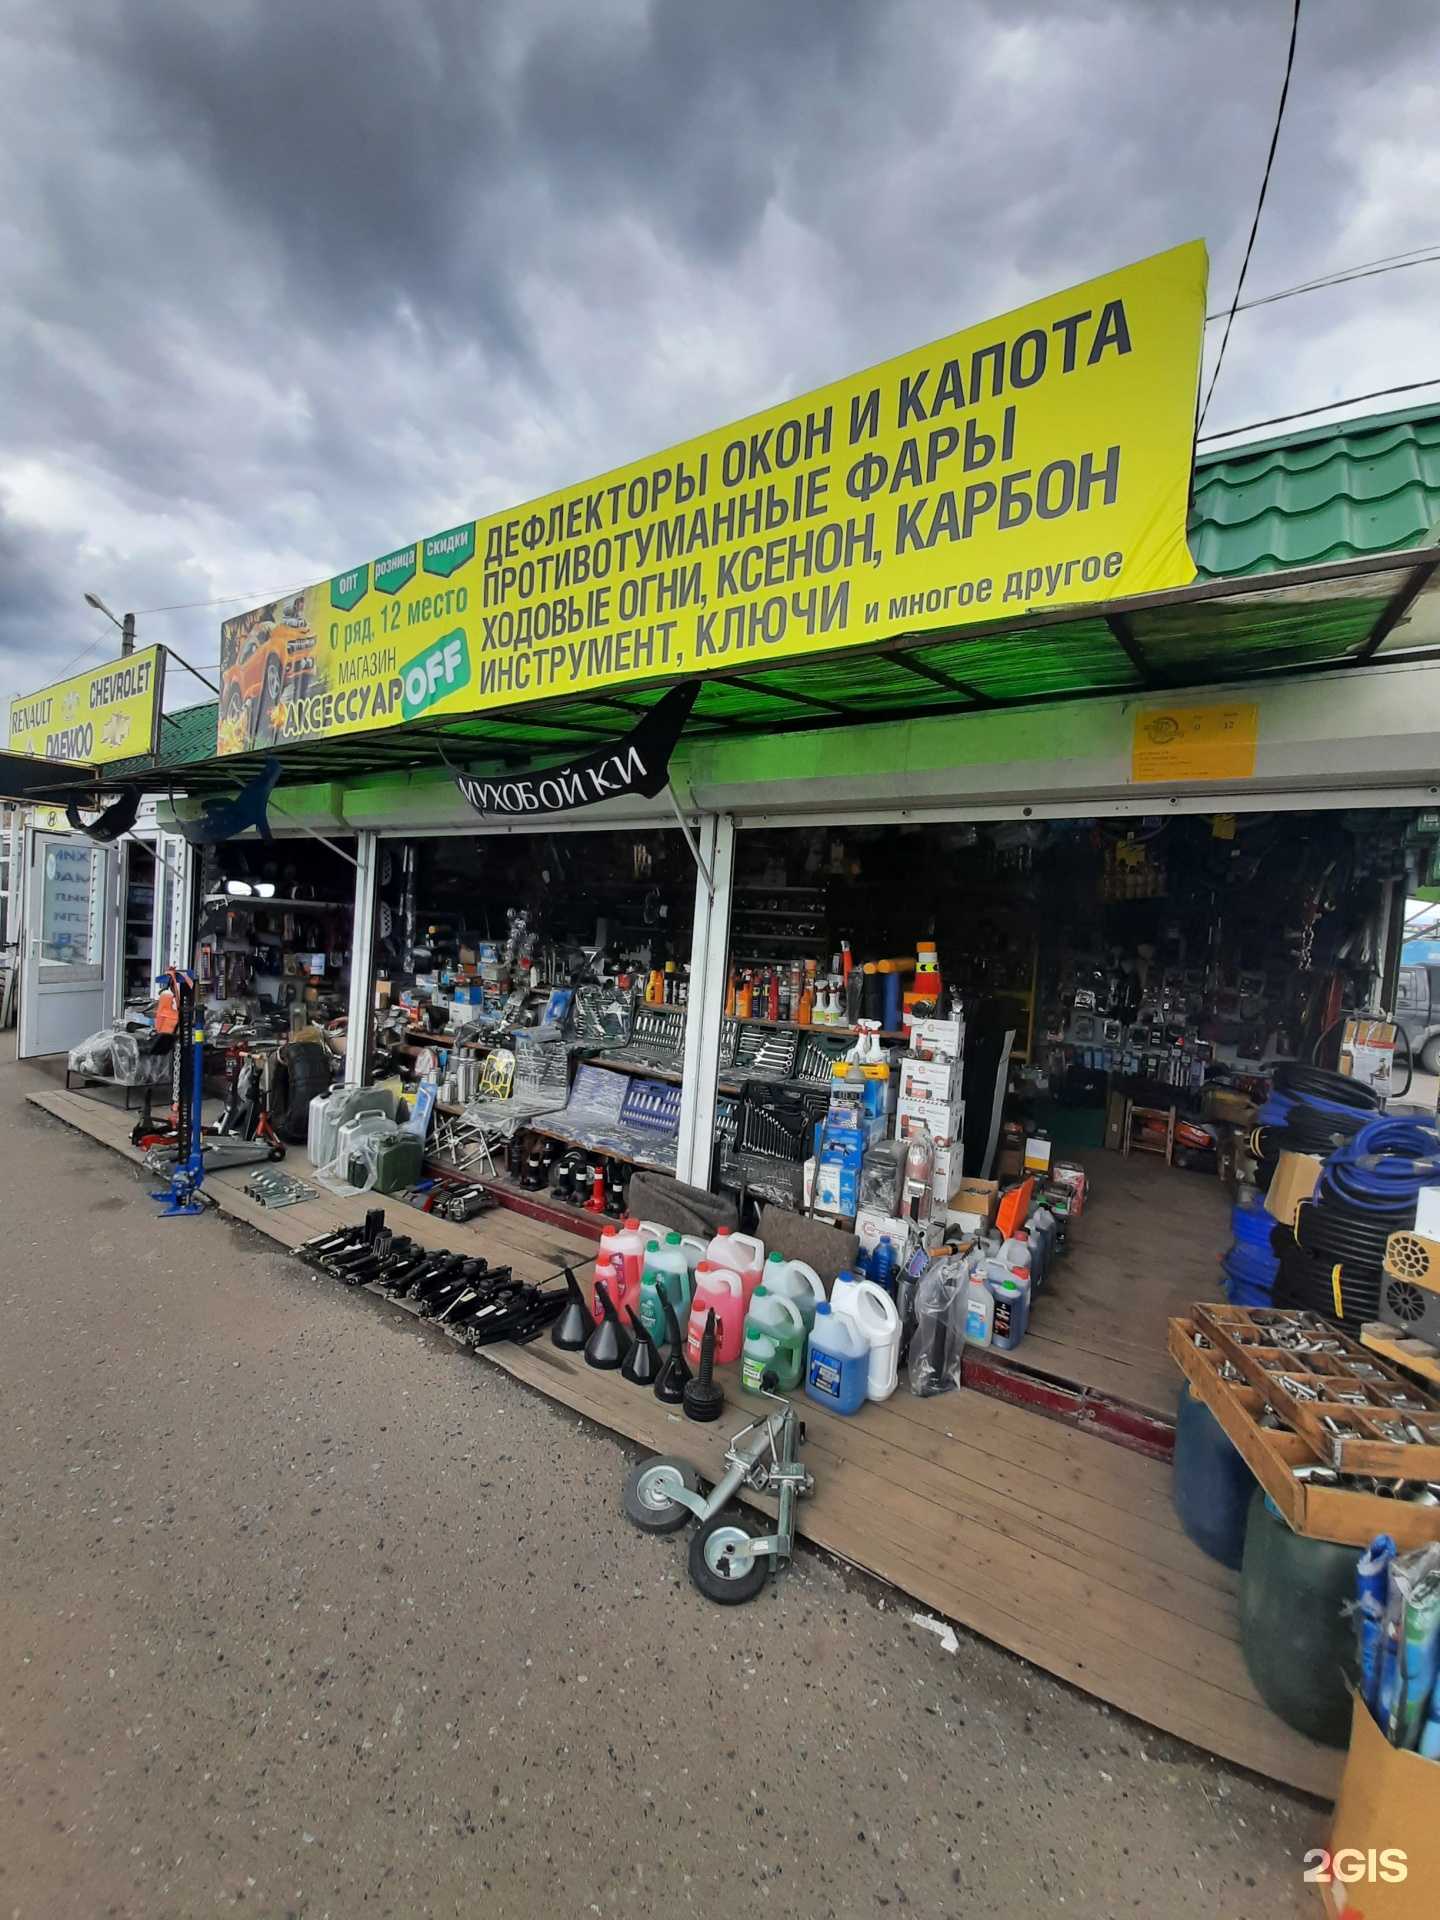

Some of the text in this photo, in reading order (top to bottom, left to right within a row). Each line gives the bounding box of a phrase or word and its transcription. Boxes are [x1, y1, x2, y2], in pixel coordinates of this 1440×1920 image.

[484, 299, 1132, 571] ДЕФЛЕКТОРЫ ОКОН И КАПОТА
[483, 405, 1017, 608] ПРОТИВОТУМАННЫЕ ФАРЫ
[375, 550, 415, 578] розница
[426, 531, 468, 556] скидки
[481, 445, 1121, 652] ХОДОВЫЕ ОГНИ, КСЕНОН, КАРБОН
[339, 573, 358, 594] опт
[381, 602, 401, 633] 12
[407, 586, 468, 626] место
[480, 550, 1124, 695] ИНСТРУМЕНТ, КЛЮЧИ и многое другое
[338, 647, 396, 685] МАГАЗИН
[11, 661, 152, 736] RENAULT CHEVROLET
[46, 722, 94, 761] DAEWOO
